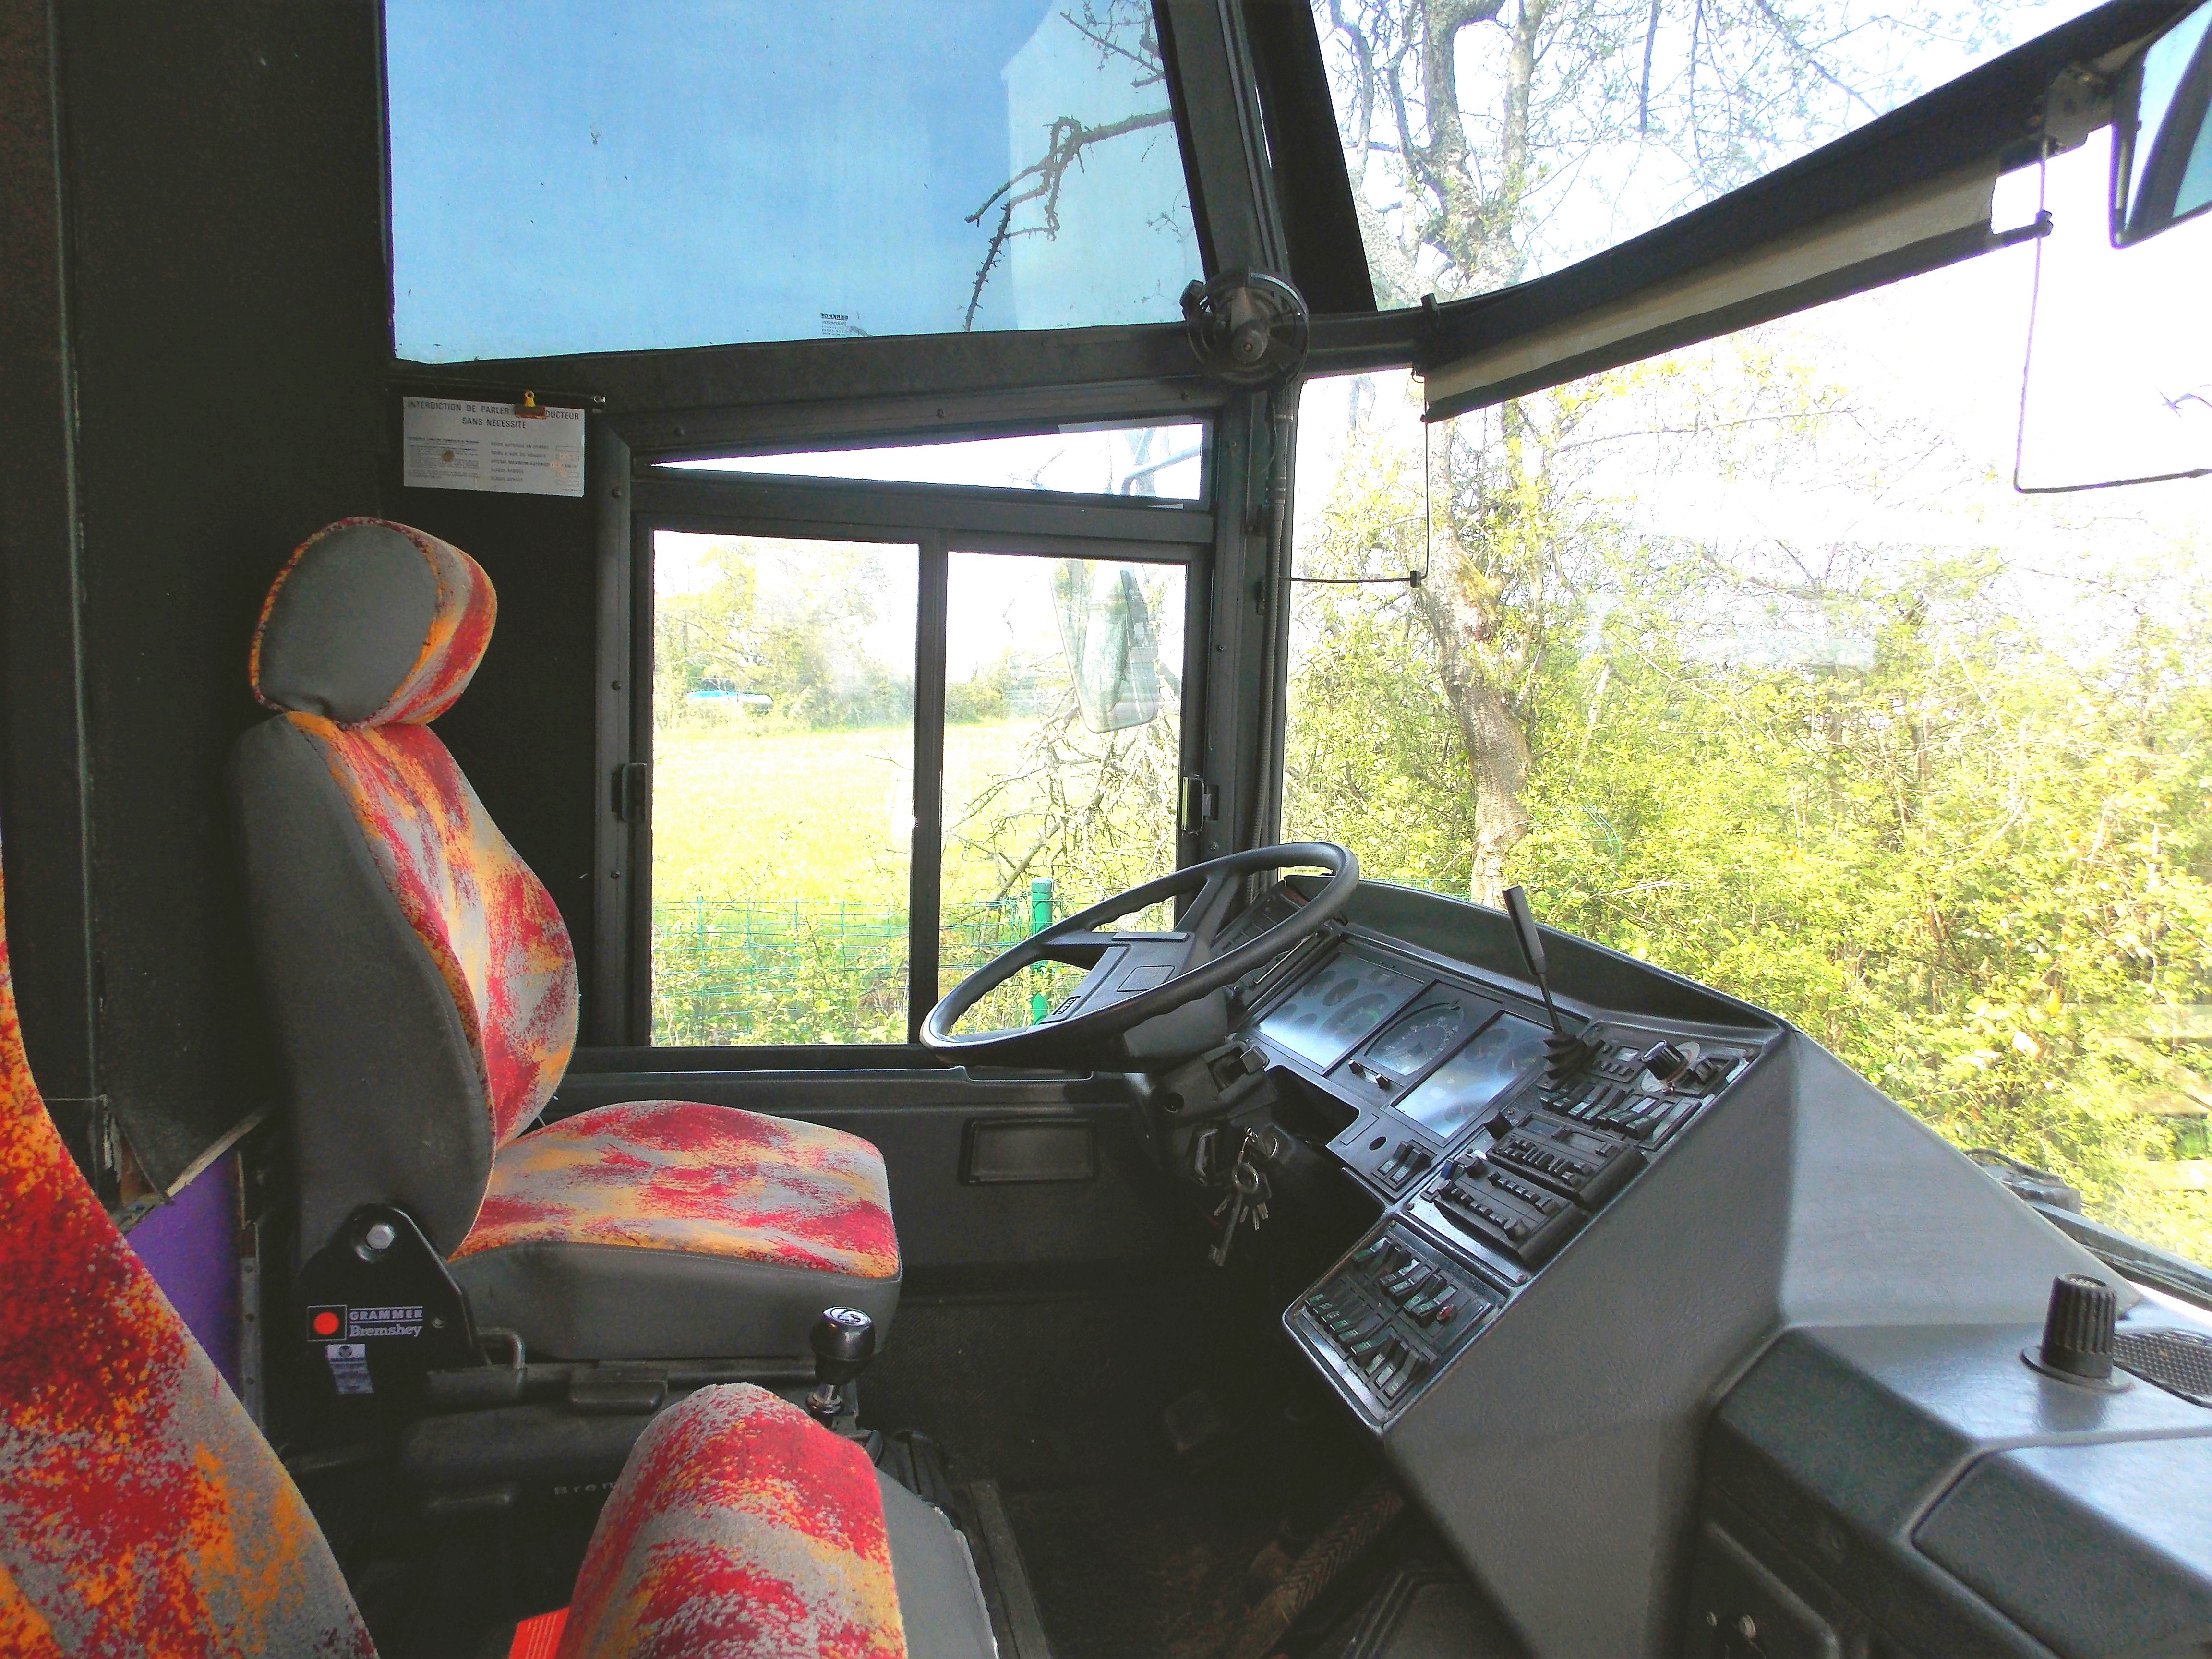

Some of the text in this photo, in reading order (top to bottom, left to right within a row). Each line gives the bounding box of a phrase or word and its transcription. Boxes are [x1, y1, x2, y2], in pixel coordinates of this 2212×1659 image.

[407, 401, 461, 411] INTERDICTION
[481, 405, 509, 414] PARLER
[546, 410, 579, 420] DUCTEUR
[462, 417, 527, 429] SANS NECESSITE
[349, 1309, 422, 1320] GRAMMER
[350, 1323, 422, 1338] Bremshey
